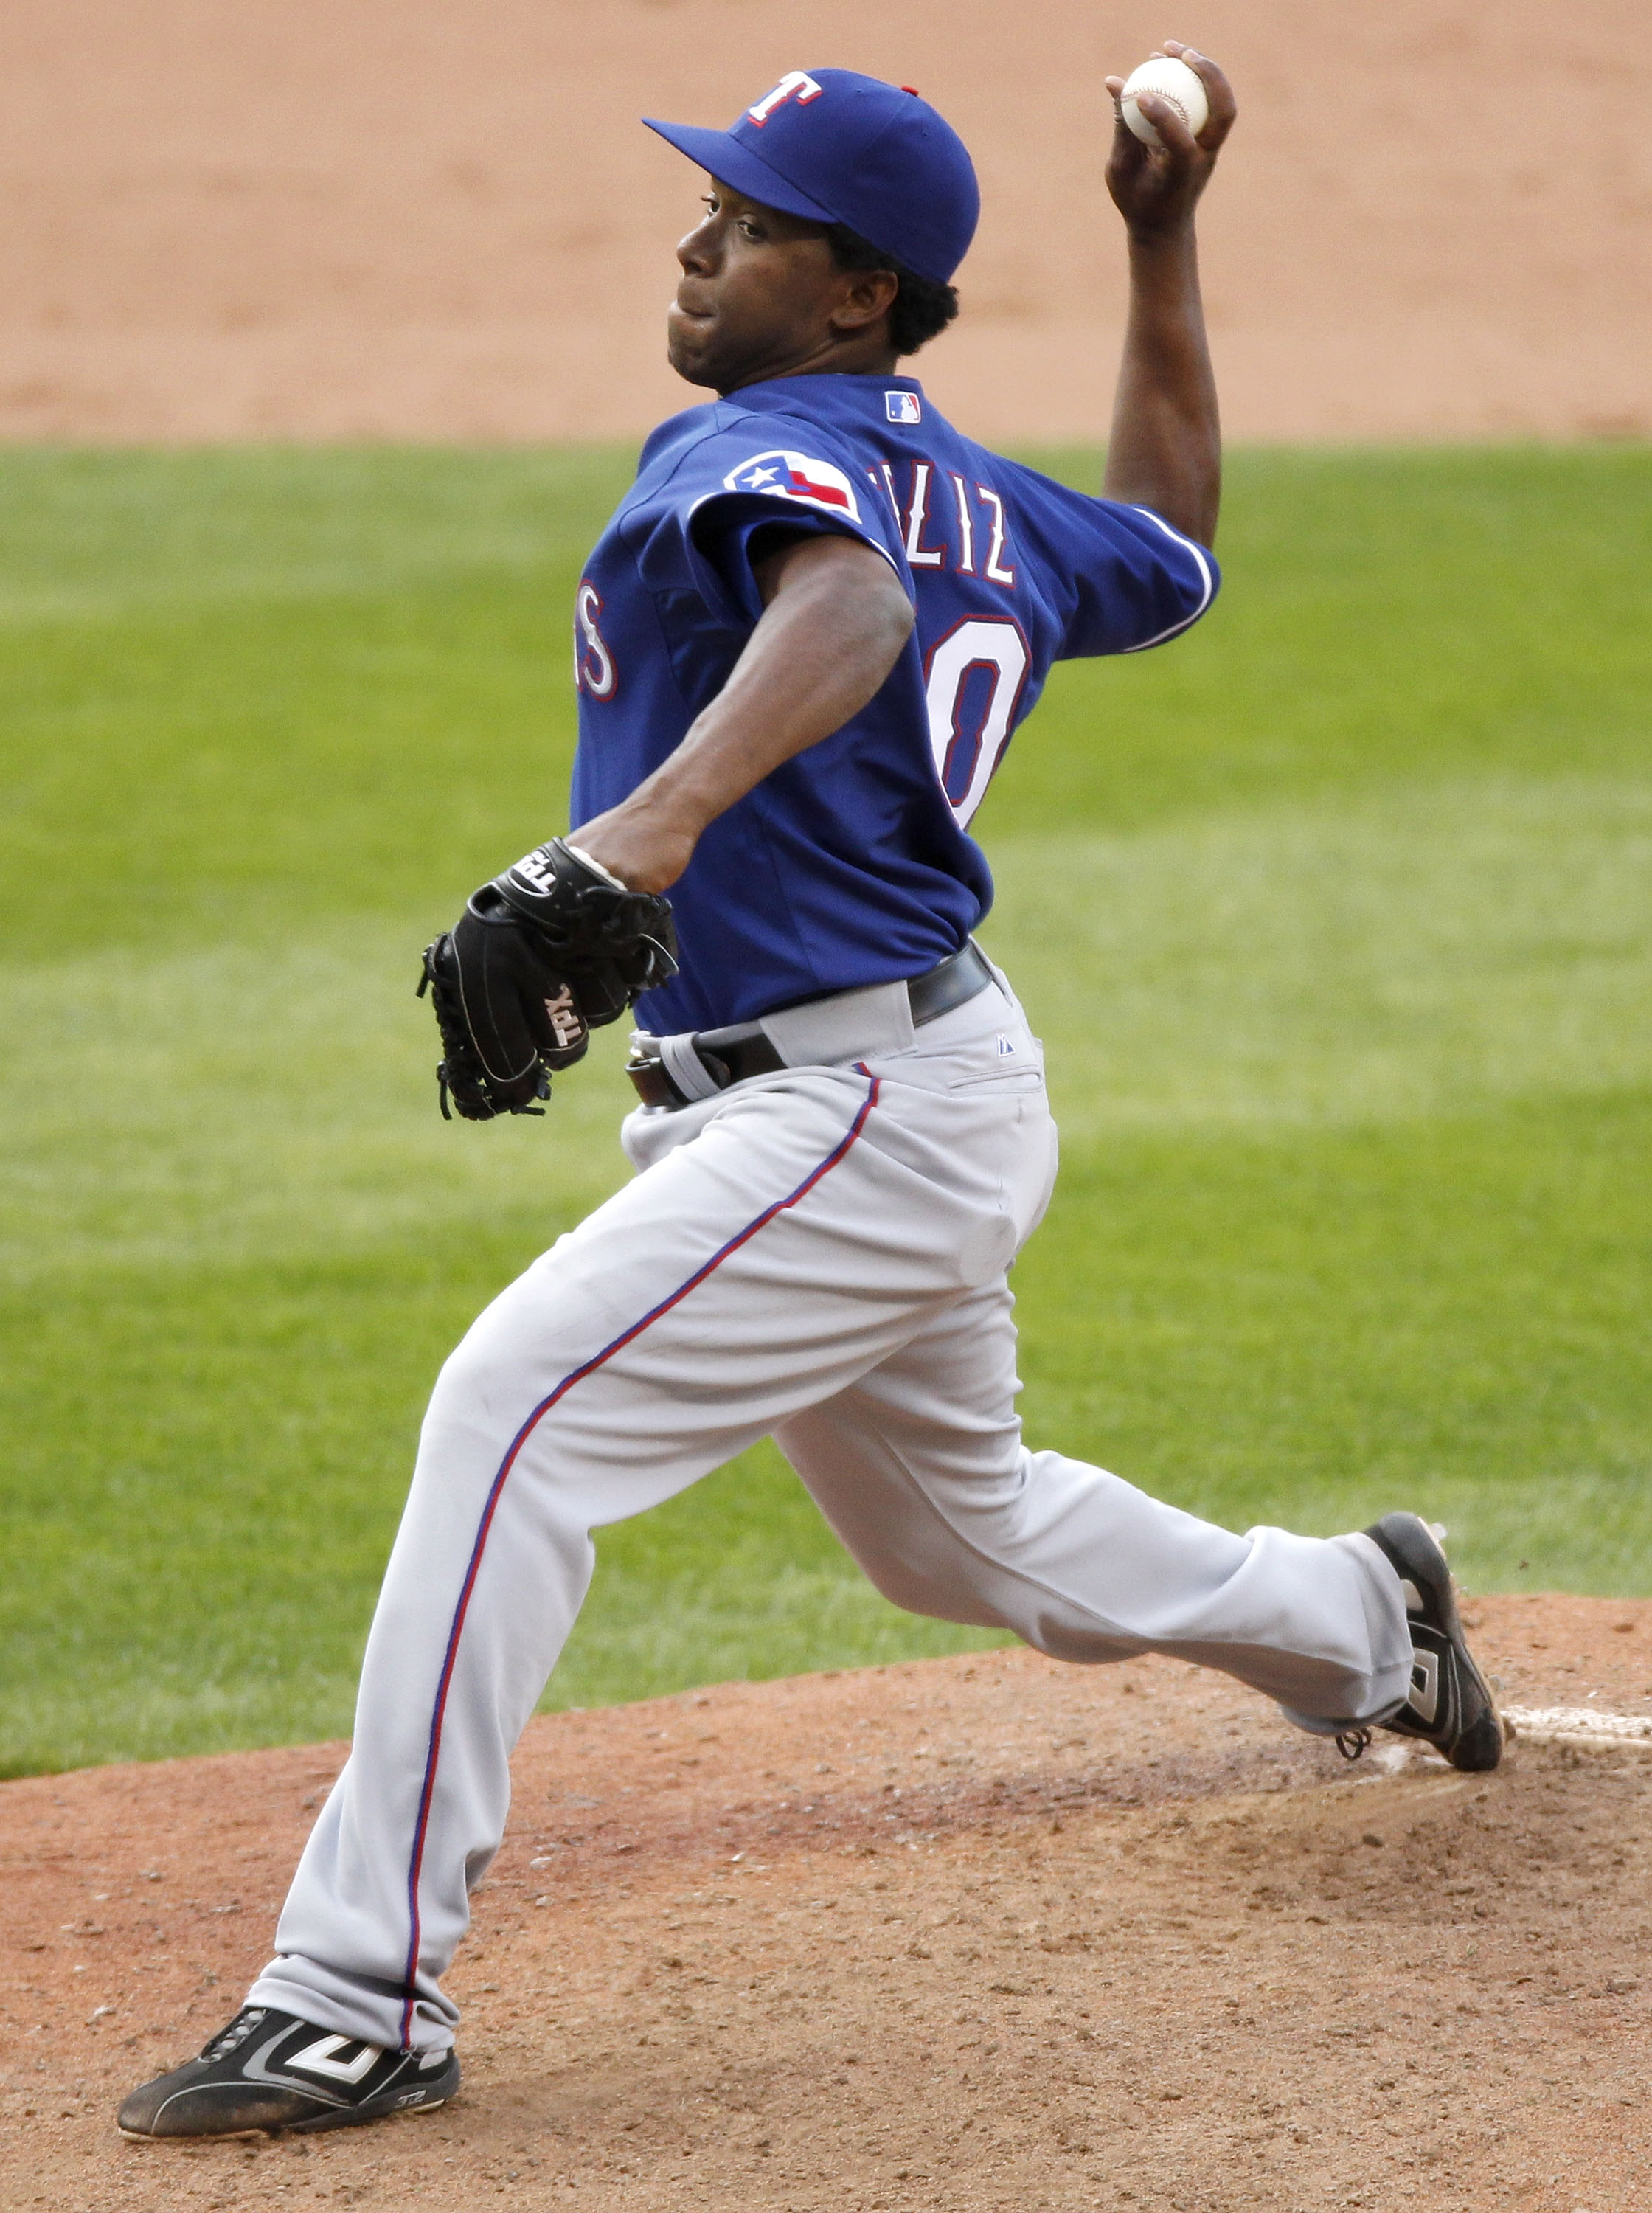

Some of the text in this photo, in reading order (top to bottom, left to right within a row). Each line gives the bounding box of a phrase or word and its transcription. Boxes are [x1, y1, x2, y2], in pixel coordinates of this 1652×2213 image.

[748, 70, 822, 128] T
[866, 459, 1016, 589] LIZ
[573, 578, 619, 702] S
